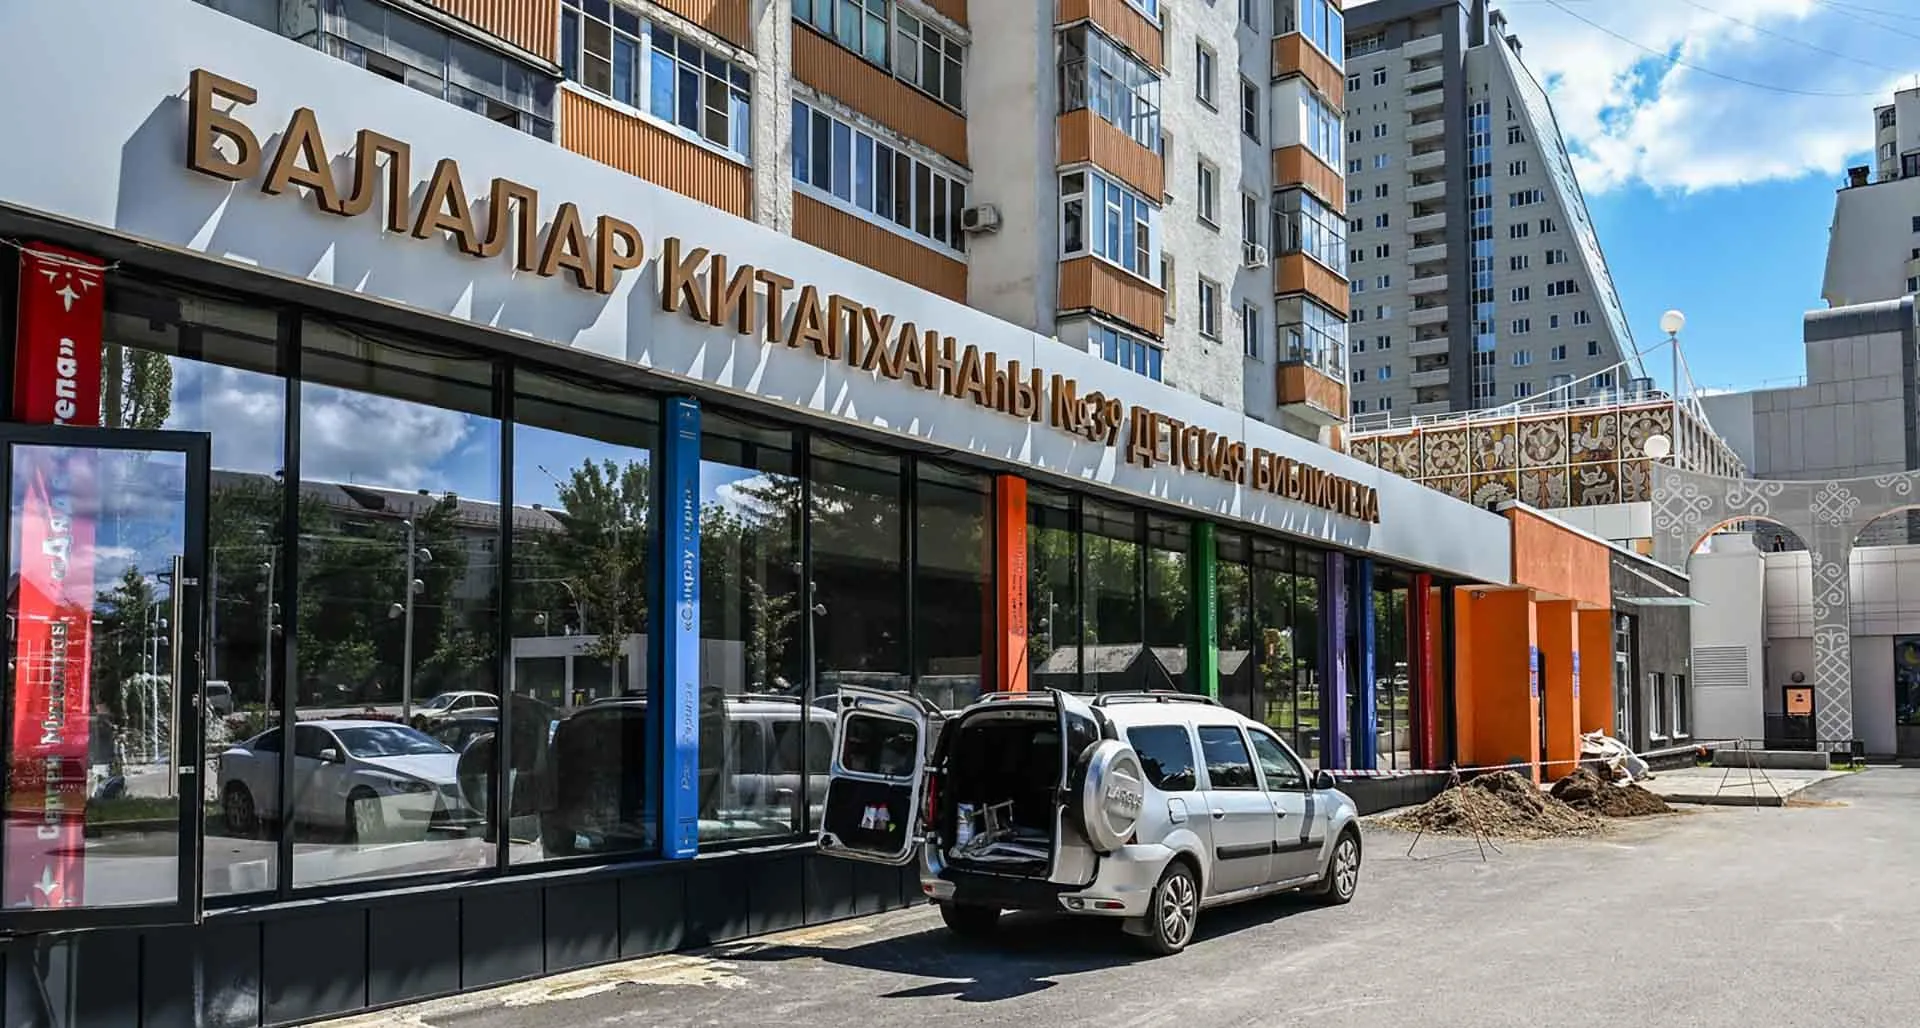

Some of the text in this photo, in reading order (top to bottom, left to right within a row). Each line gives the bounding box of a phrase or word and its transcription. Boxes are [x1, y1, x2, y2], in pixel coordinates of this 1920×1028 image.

[186, 68, 644, 294] БАЛАЛАР
[1051, 374, 1123, 447] №39
[1126, 405, 1246, 484] ДЕТСКАЯ
[1251, 447, 1381, 523] БИБЛИОТЕКА
